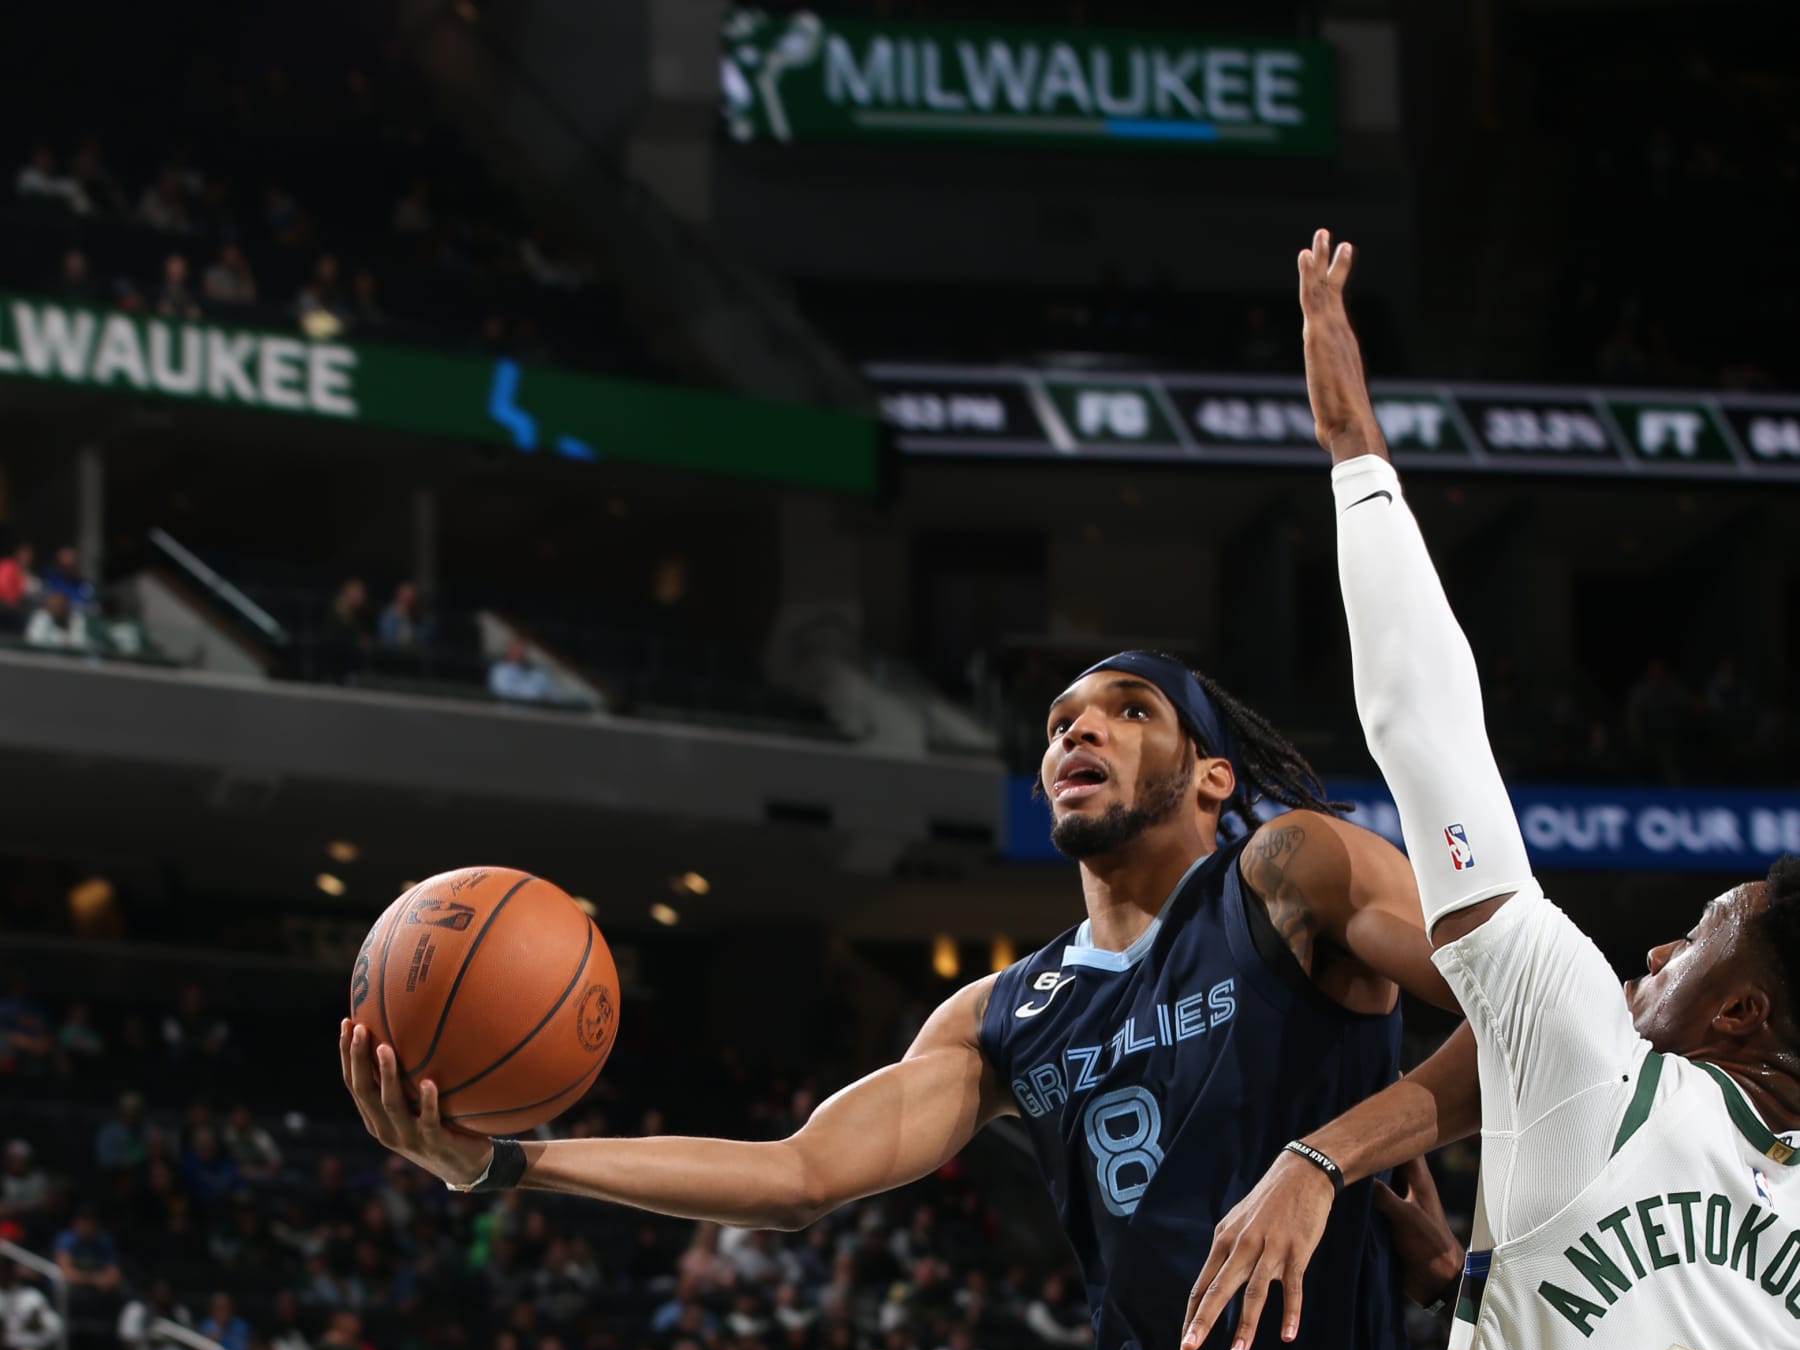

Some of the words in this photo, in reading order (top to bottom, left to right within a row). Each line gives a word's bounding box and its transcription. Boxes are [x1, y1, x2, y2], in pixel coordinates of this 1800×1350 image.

[825, 34, 1304, 124] MILWAUKEE
[1638, 410, 1703, 456] FT
[1522, 803, 1629, 850] OUT
[1635, 804, 1747, 854] OUR
[1032, 972, 1061, 991] 6
[1084, 1085, 1165, 1217] 8
